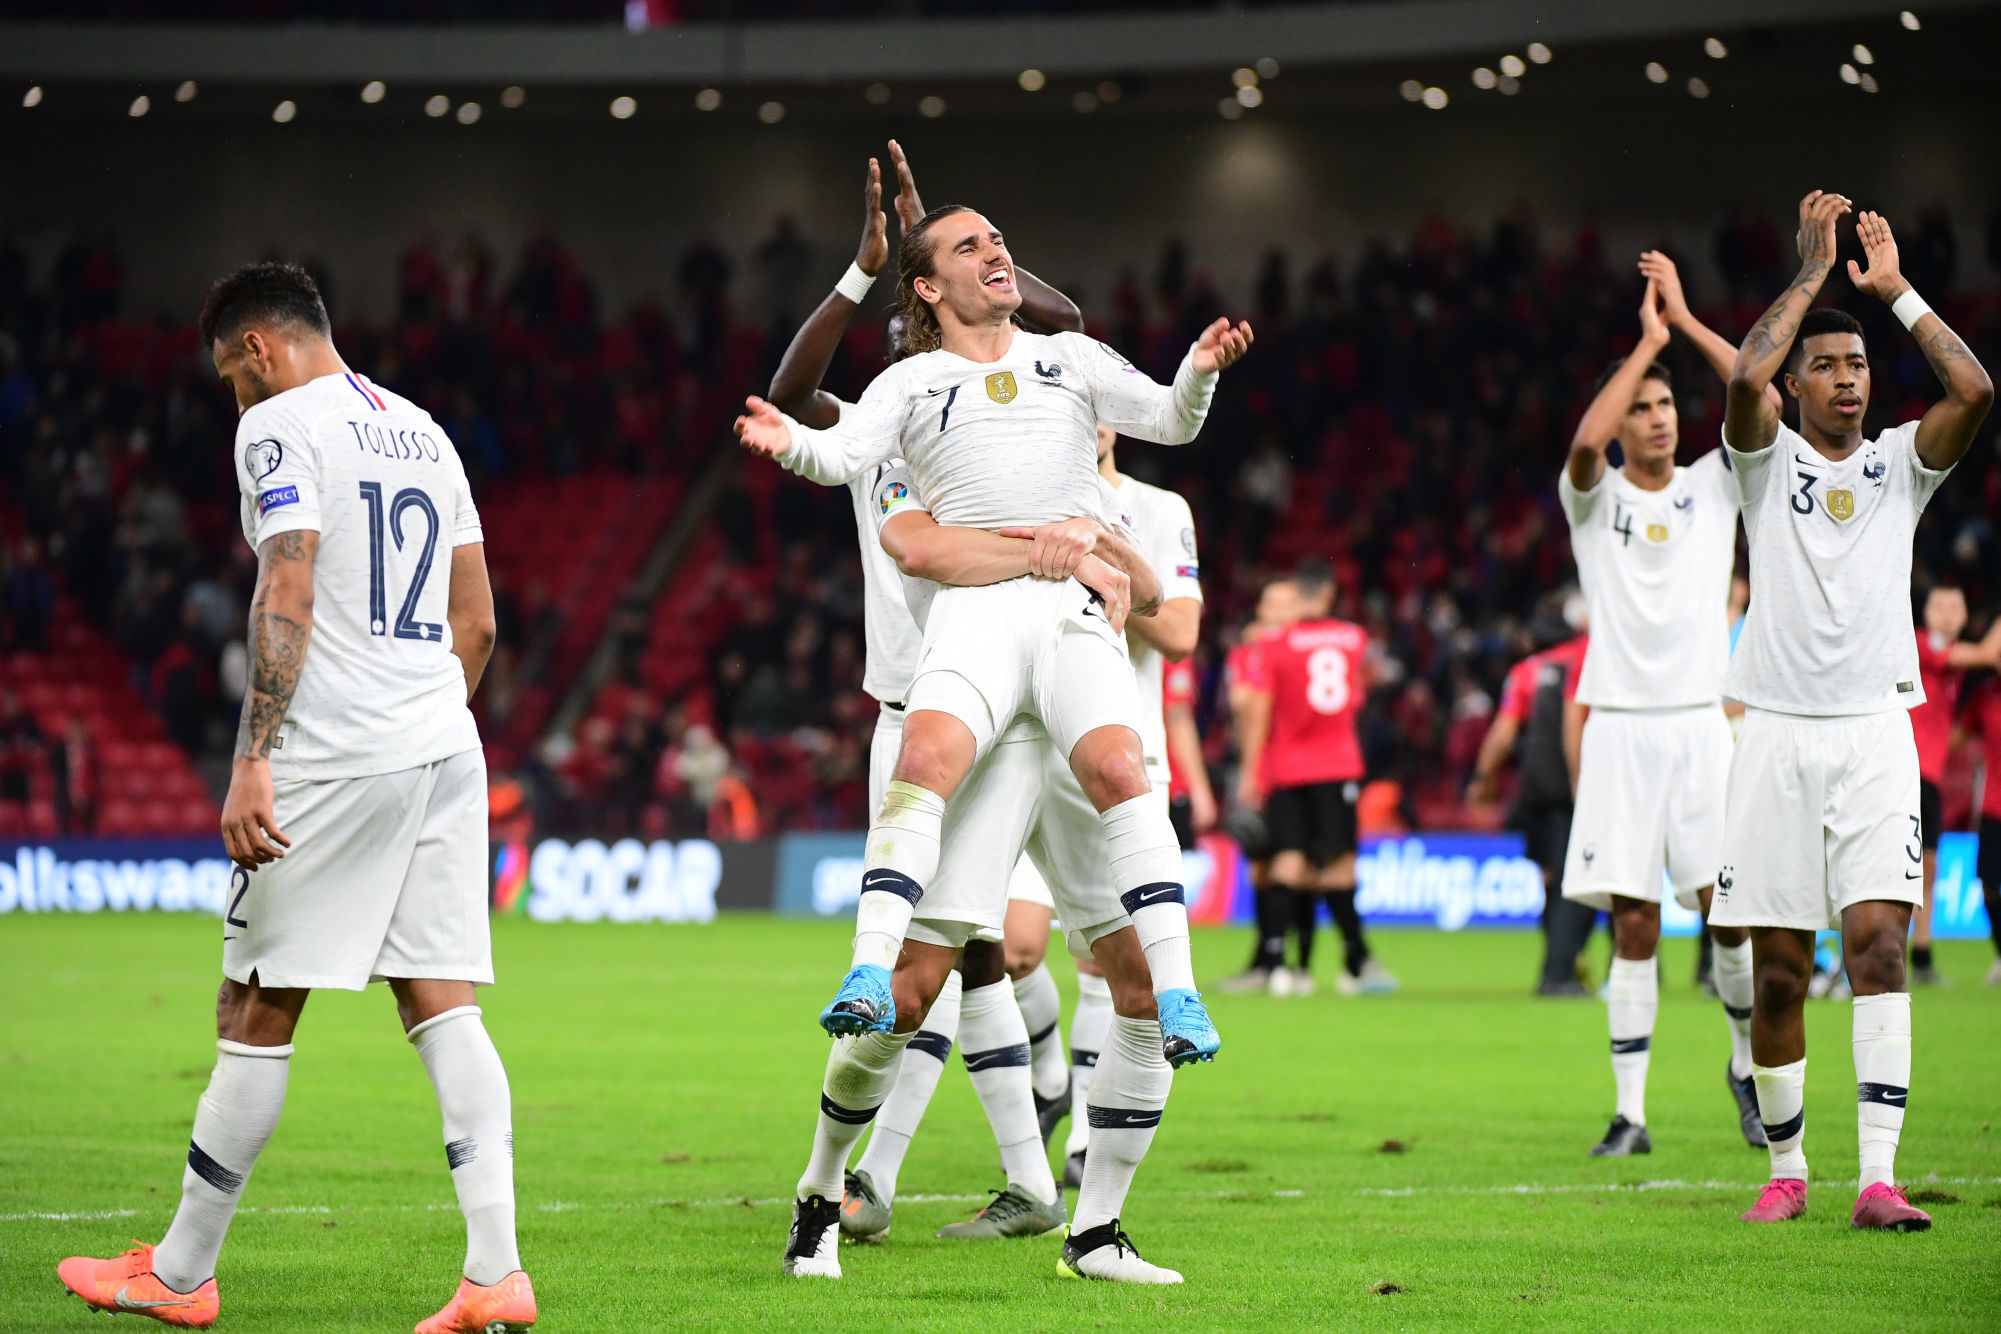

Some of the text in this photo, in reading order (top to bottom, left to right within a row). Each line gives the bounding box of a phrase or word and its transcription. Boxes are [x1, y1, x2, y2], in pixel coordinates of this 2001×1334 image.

[931, 384, 961, 432] 7
[347, 421, 439, 463] TOLISSO
[1791, 471, 1818, 515] 3
[1613, 503, 1632, 548] 4
[359, 480, 443, 643] 12
[1306, 644, 1350, 716] 8
[1906, 814, 1922, 863] 3
[527, 837, 723, 923] SOCAR
